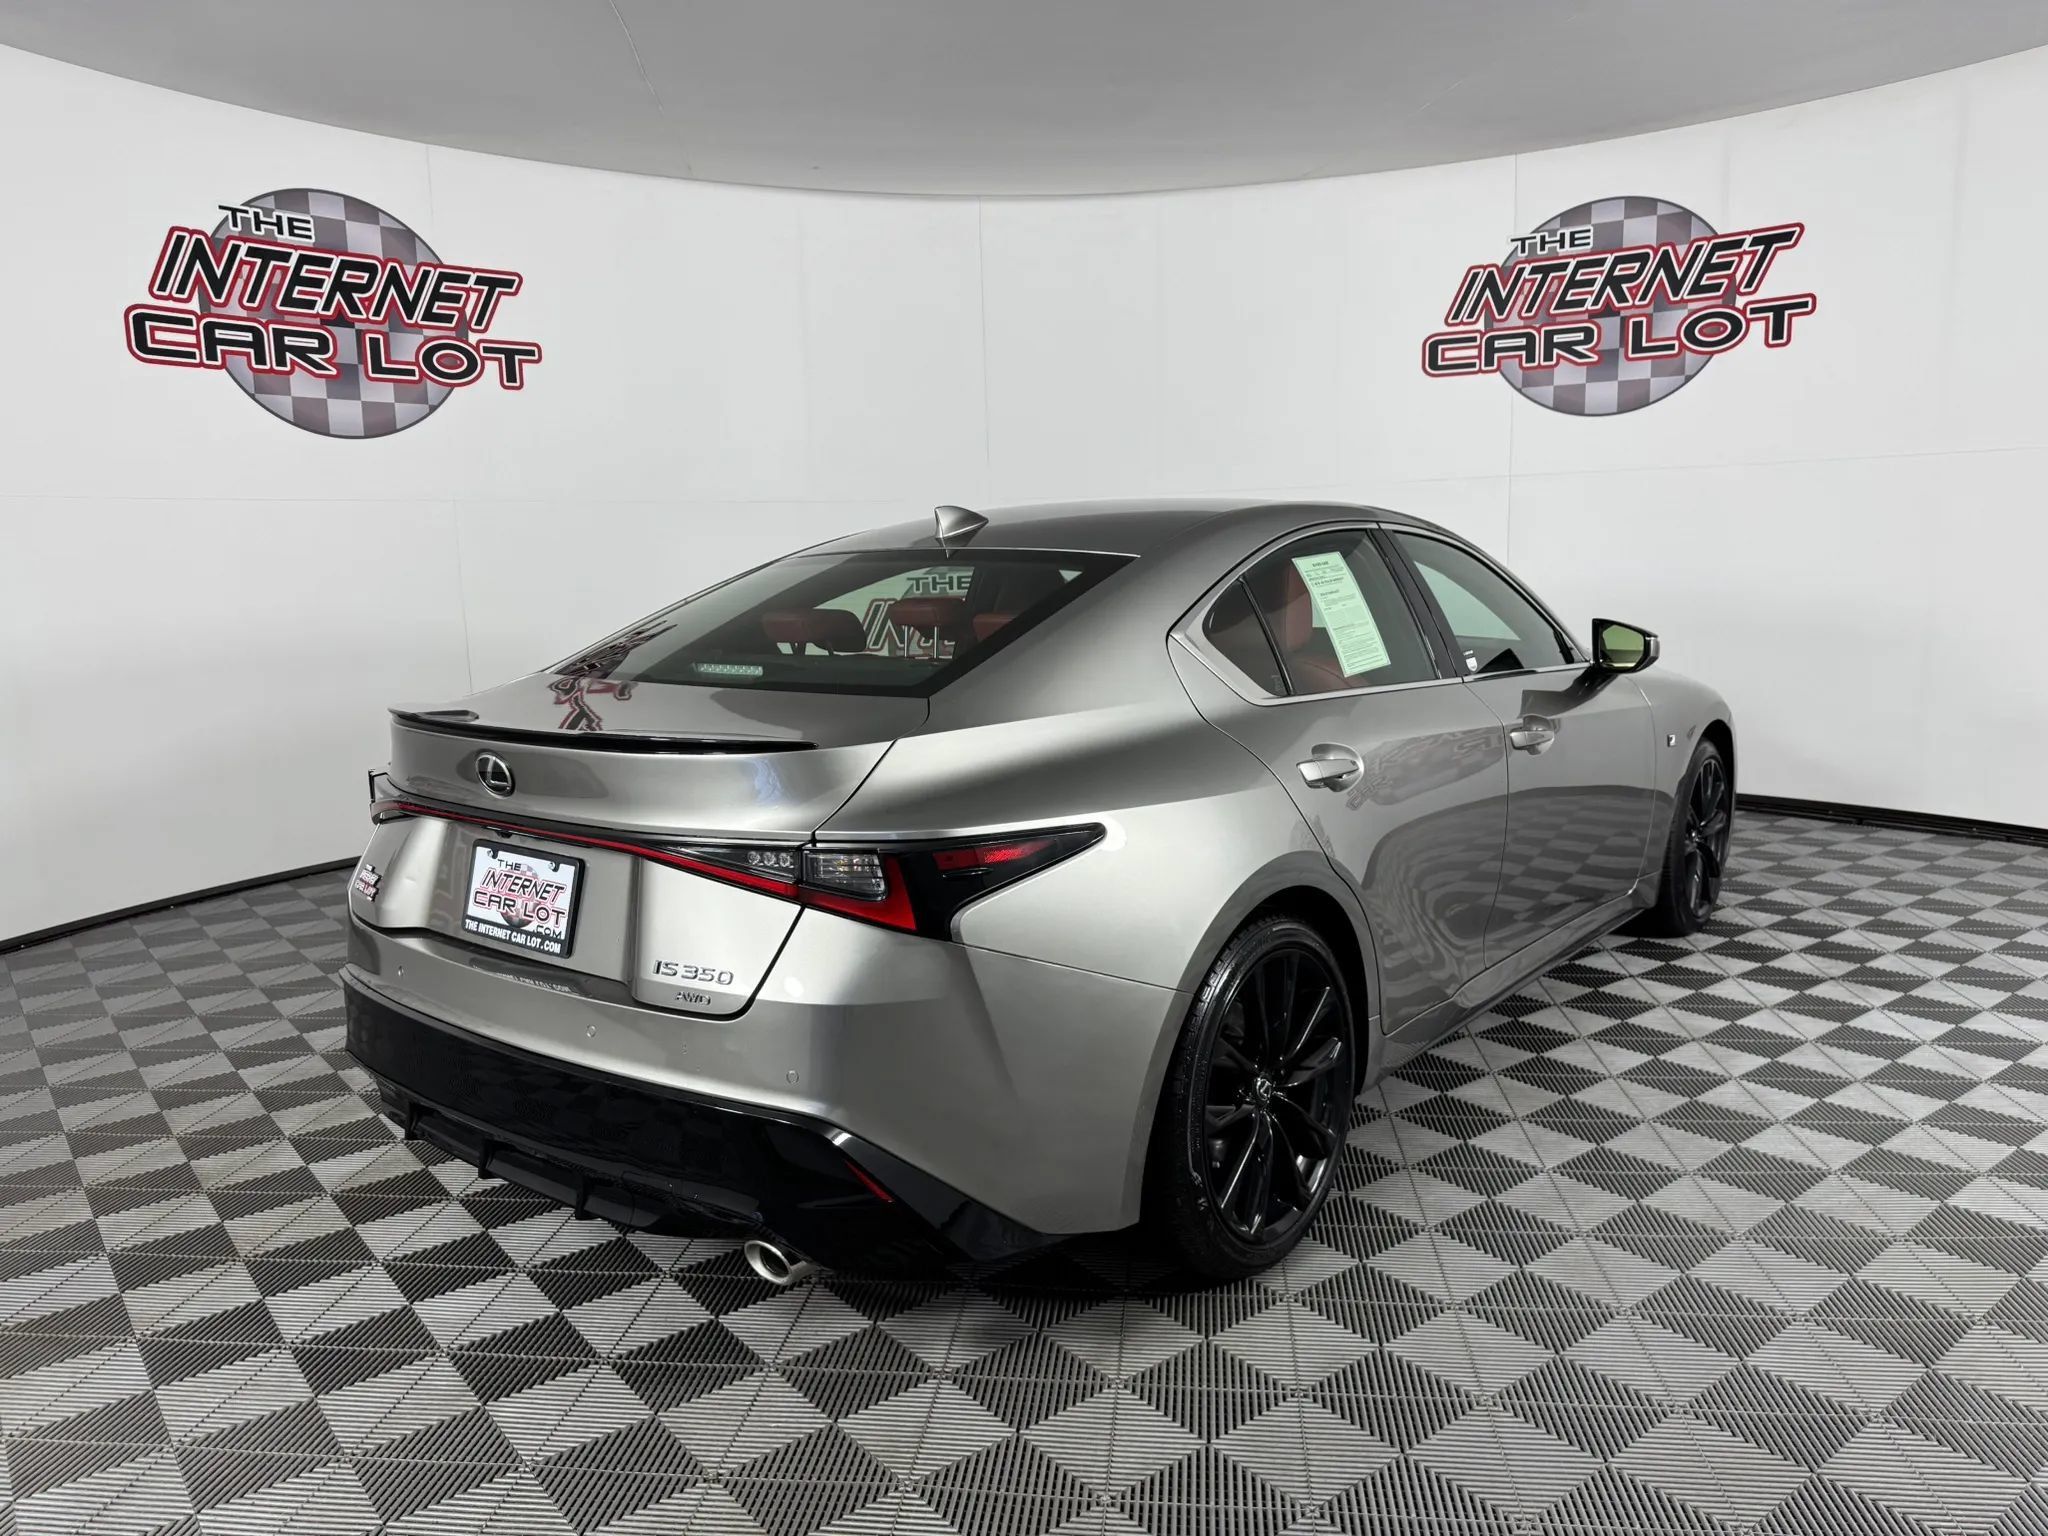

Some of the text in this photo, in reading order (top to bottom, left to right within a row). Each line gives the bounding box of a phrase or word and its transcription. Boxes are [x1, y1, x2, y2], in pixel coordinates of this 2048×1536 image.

[218, 204, 314, 241] THE
[1509, 227, 1593, 256] THE
[152, 229, 521, 331] INTERNET
[1448, 225, 1803, 323] INTERNET
[128, 308, 539, 387] CAR LOT
[1424, 296, 1813, 374] CAR LOT
[497, 859, 522, 871] THE
[481, 868, 565, 903] INTERNET
[473, 890, 566, 926] CAR LOT
[465, 920, 478, 931] THE
[478, 923, 511, 940] INTERNET
[511, 931, 527, 943] CAR
[674, 991, 711, 1006] AWD
